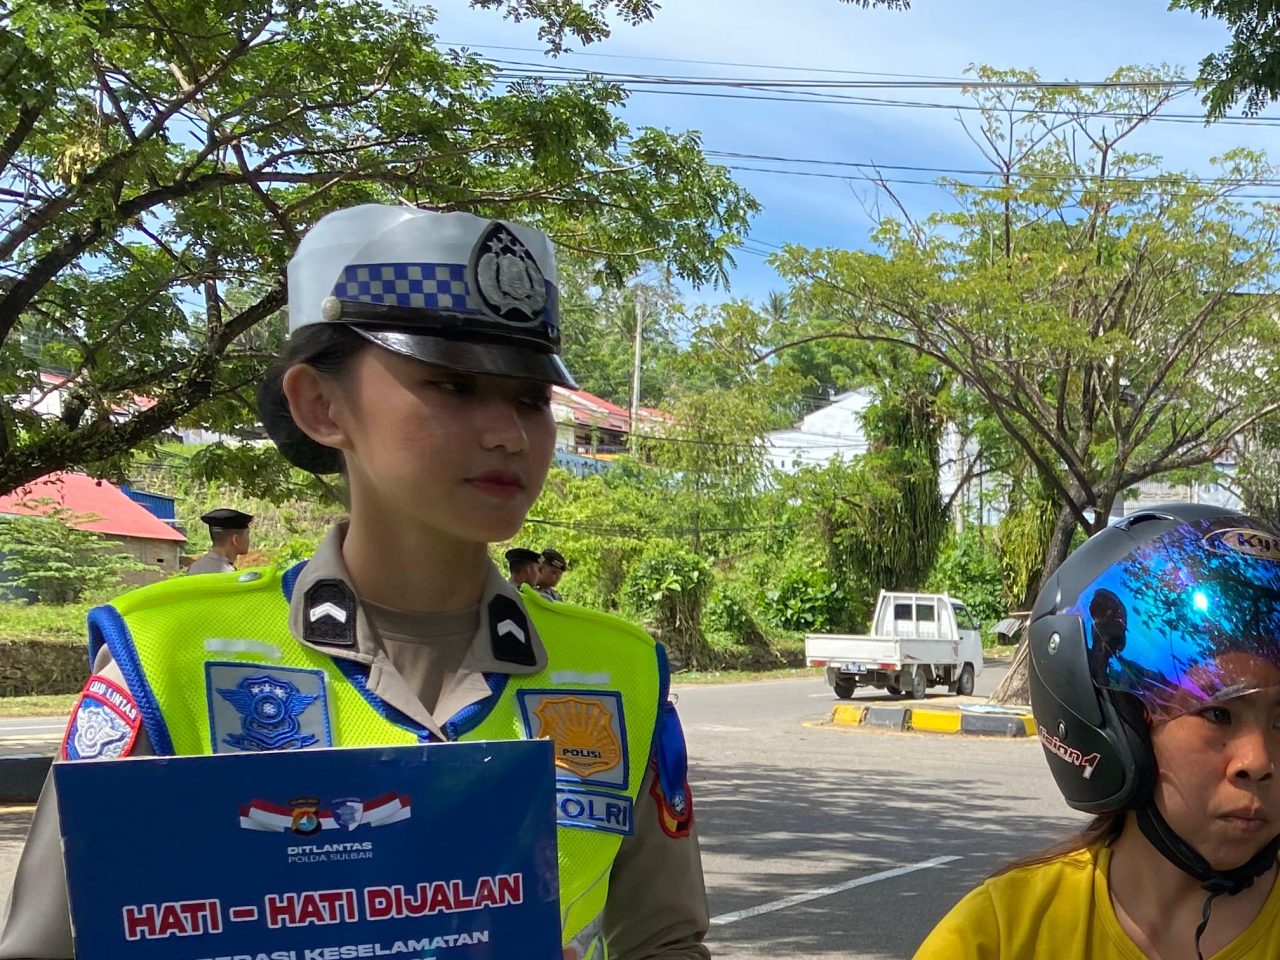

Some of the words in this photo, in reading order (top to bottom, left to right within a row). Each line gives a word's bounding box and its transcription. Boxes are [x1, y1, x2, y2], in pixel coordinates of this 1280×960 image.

[106, 688, 137, 721] LINTAS
[562, 748, 602, 759] POLISI
[560, 797, 628, 827] OLRI
[287, 841, 373, 855] DITLANTAS
[288, 854, 327, 863] POLDA
[330, 851, 373, 861] SULBAR
[123, 899, 223, 941] HATI
[264, 888, 358, 929] HATI
[364, 873, 524, 921] DIJALAN
